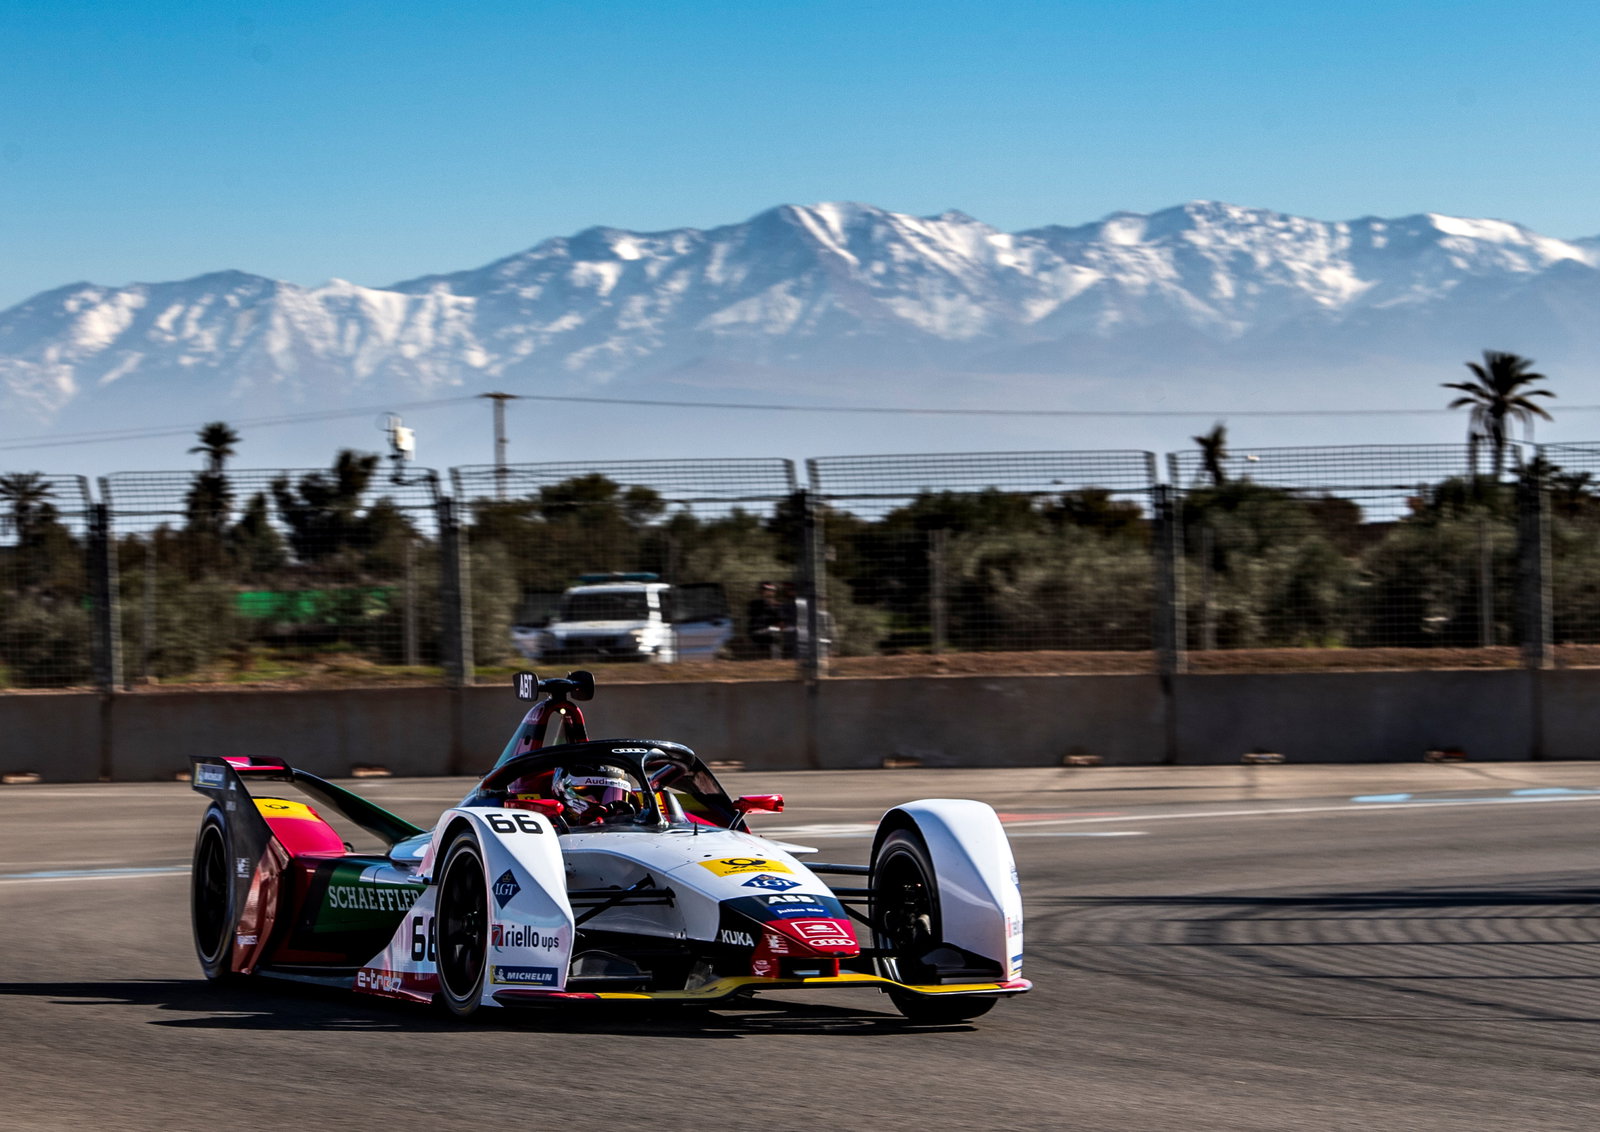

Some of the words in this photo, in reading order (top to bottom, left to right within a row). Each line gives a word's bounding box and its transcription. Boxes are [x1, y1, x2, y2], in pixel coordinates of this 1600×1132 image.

[519, 674, 533, 698] ABT
[485, 814, 544, 834] 66
[496, 884, 516, 896] LGT
[768, 895, 816, 904] ABB
[505, 925, 540, 948] riello
[542, 936, 560, 952] ups
[720, 929, 754, 946] KUKA
[358, 970, 402, 992] e-tron
[507, 972, 552, 981] MICHELIN
